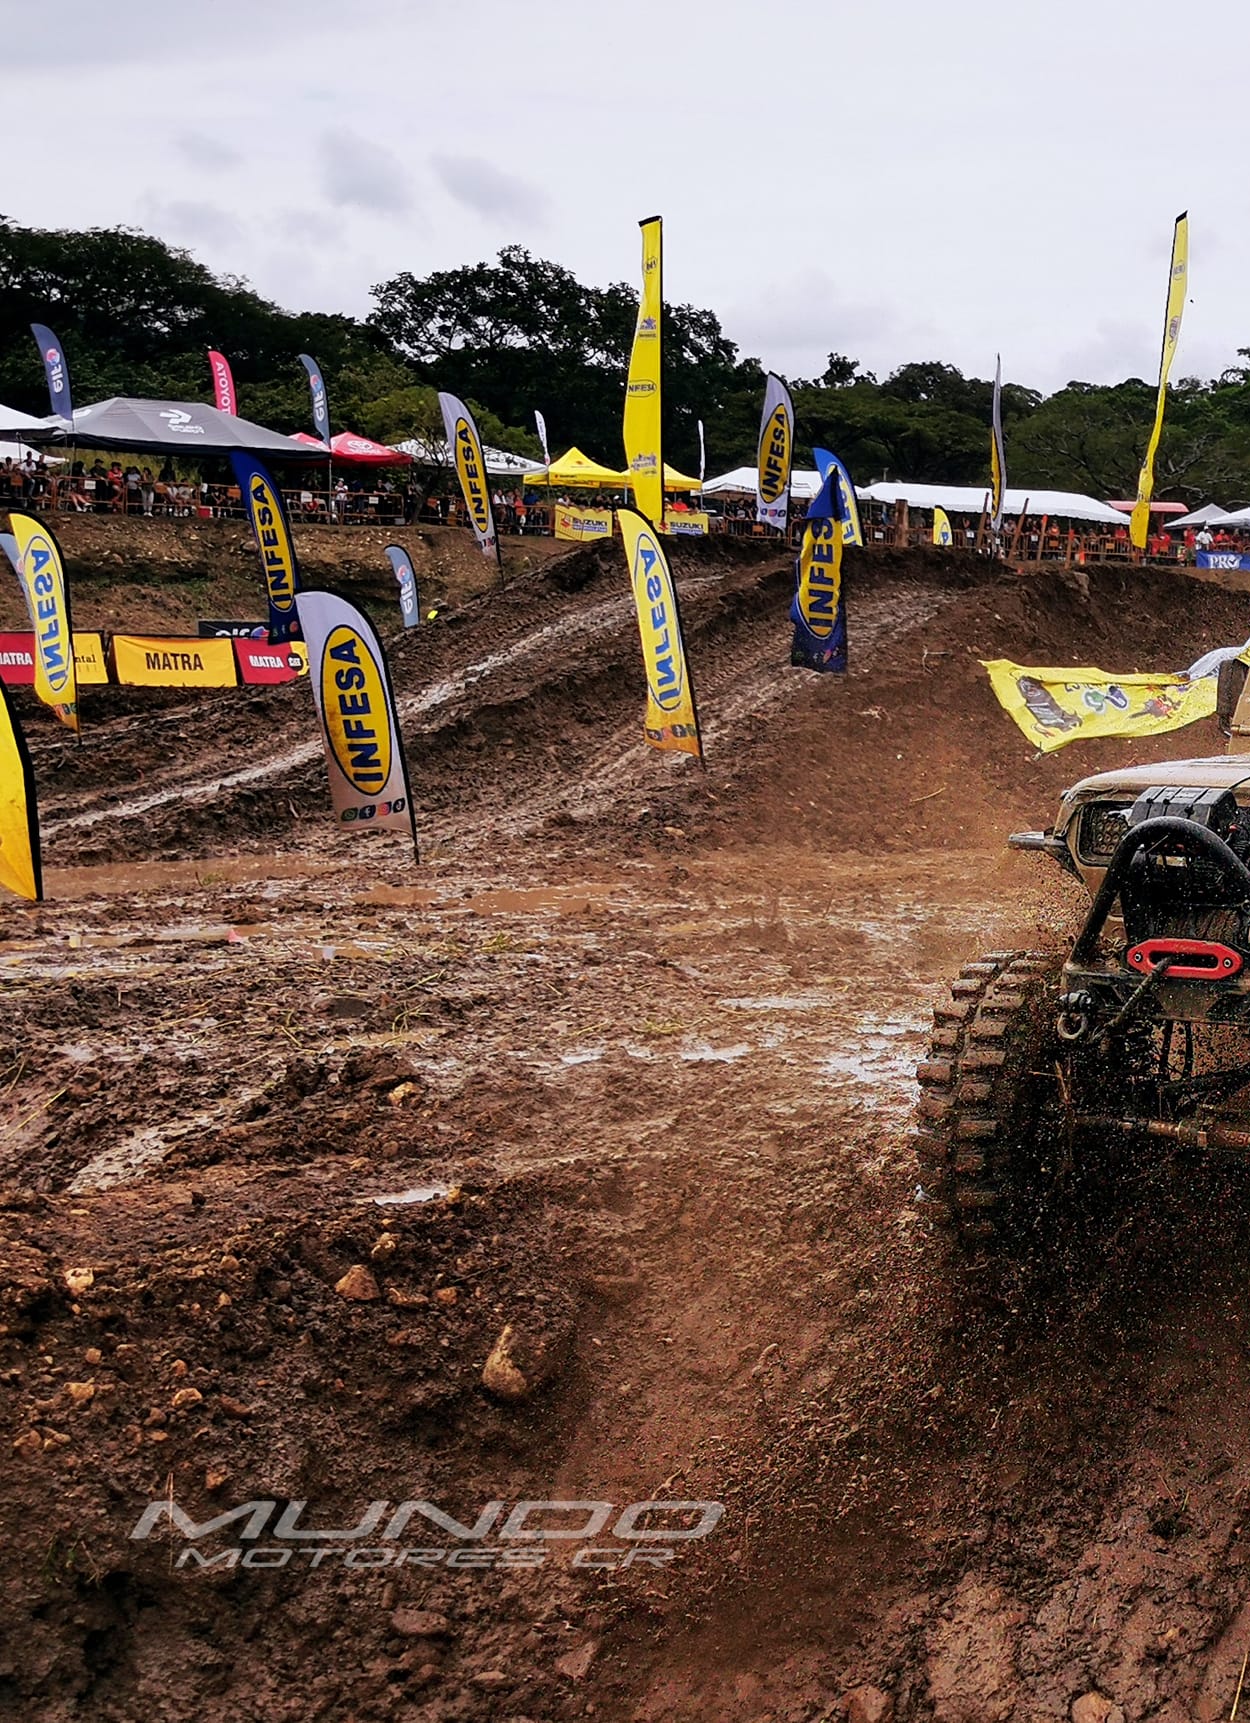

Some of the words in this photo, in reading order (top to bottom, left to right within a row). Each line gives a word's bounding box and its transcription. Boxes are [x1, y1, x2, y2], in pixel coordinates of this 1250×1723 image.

[458, 427, 487, 524] INFESA
[762, 413, 785, 497] INFESA
[252, 483, 291, 602] INFESA
[670, 522, 704, 530] SUZUKI
[808, 518, 835, 628] INFES
[145, 652, 204, 671] MATRA
[249, 655, 284, 668] MATRA
[329, 638, 384, 782] INFESA
